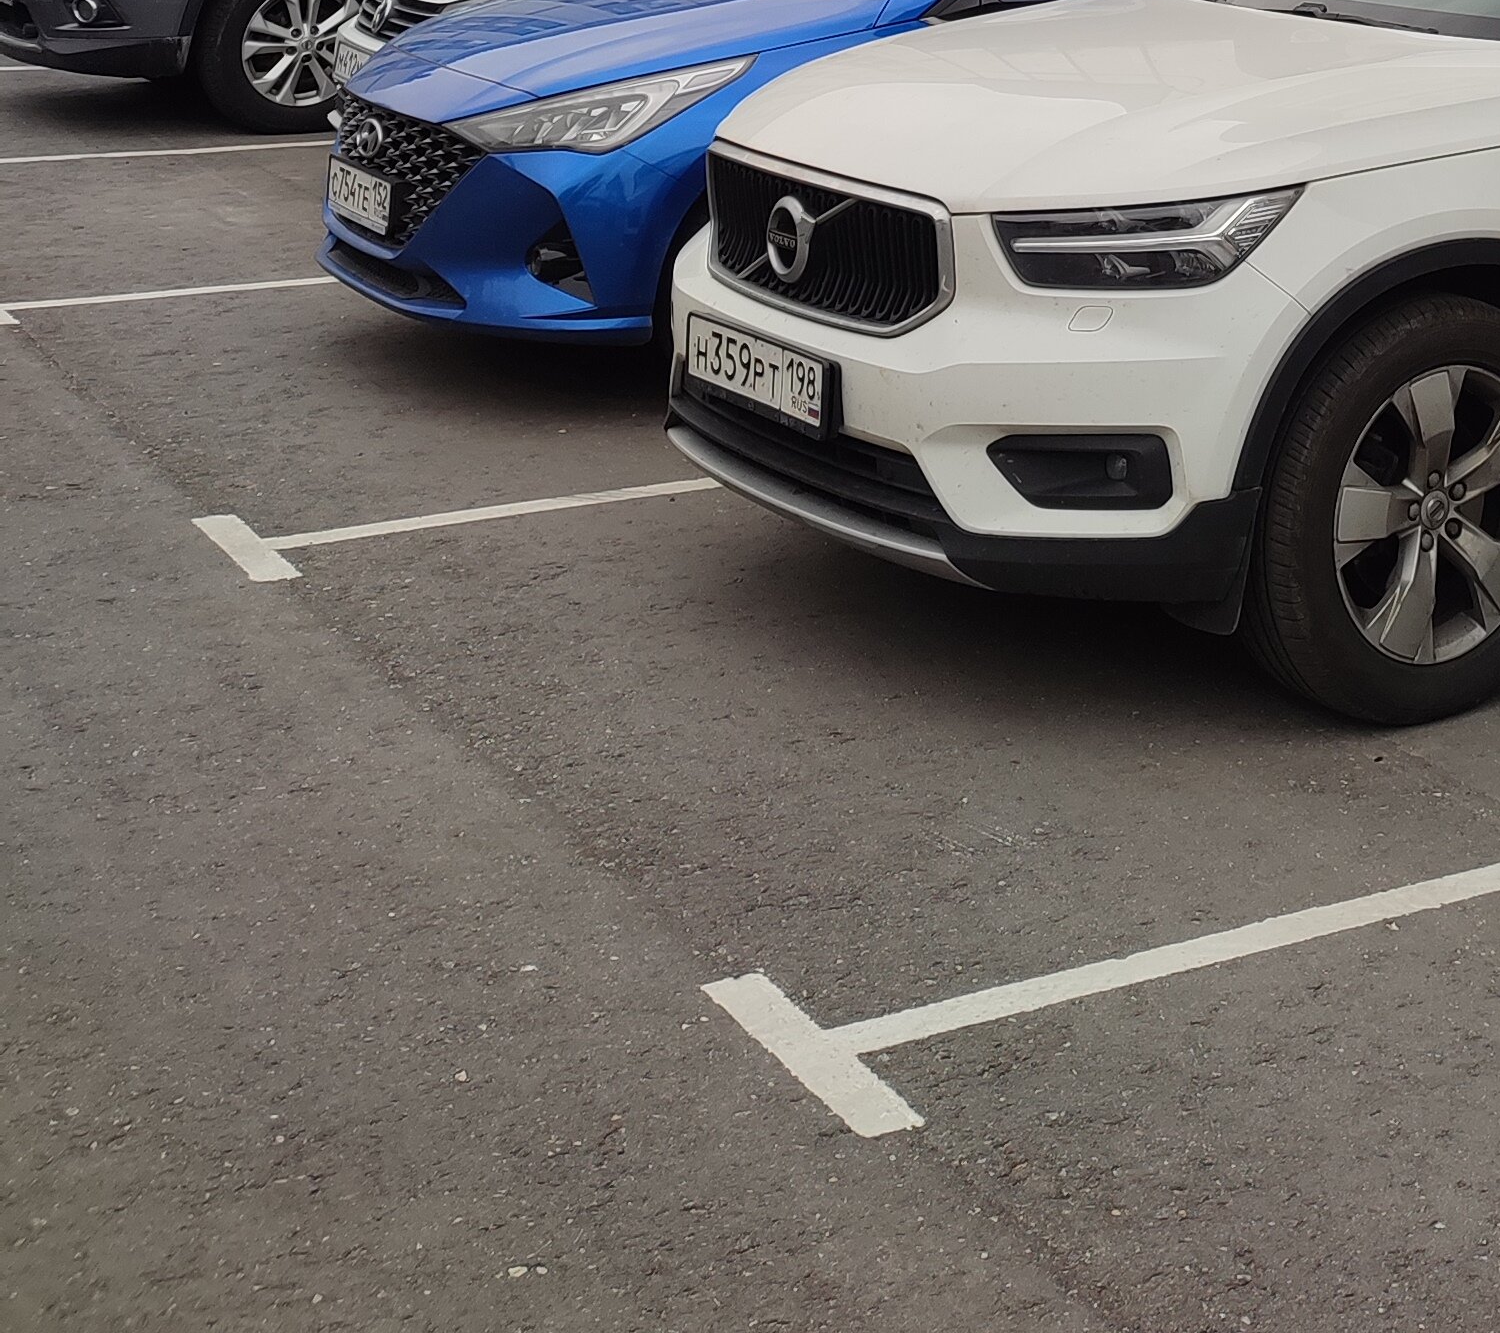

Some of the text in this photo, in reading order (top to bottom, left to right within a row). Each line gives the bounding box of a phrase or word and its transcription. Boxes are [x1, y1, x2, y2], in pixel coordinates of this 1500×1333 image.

[331, 166, 388, 212] С754ТЕ 152
[769, 232, 796, 248] VOLVO
[695, 330, 817, 401] Н359РТ 198
[791, 396, 808, 414] RUS
